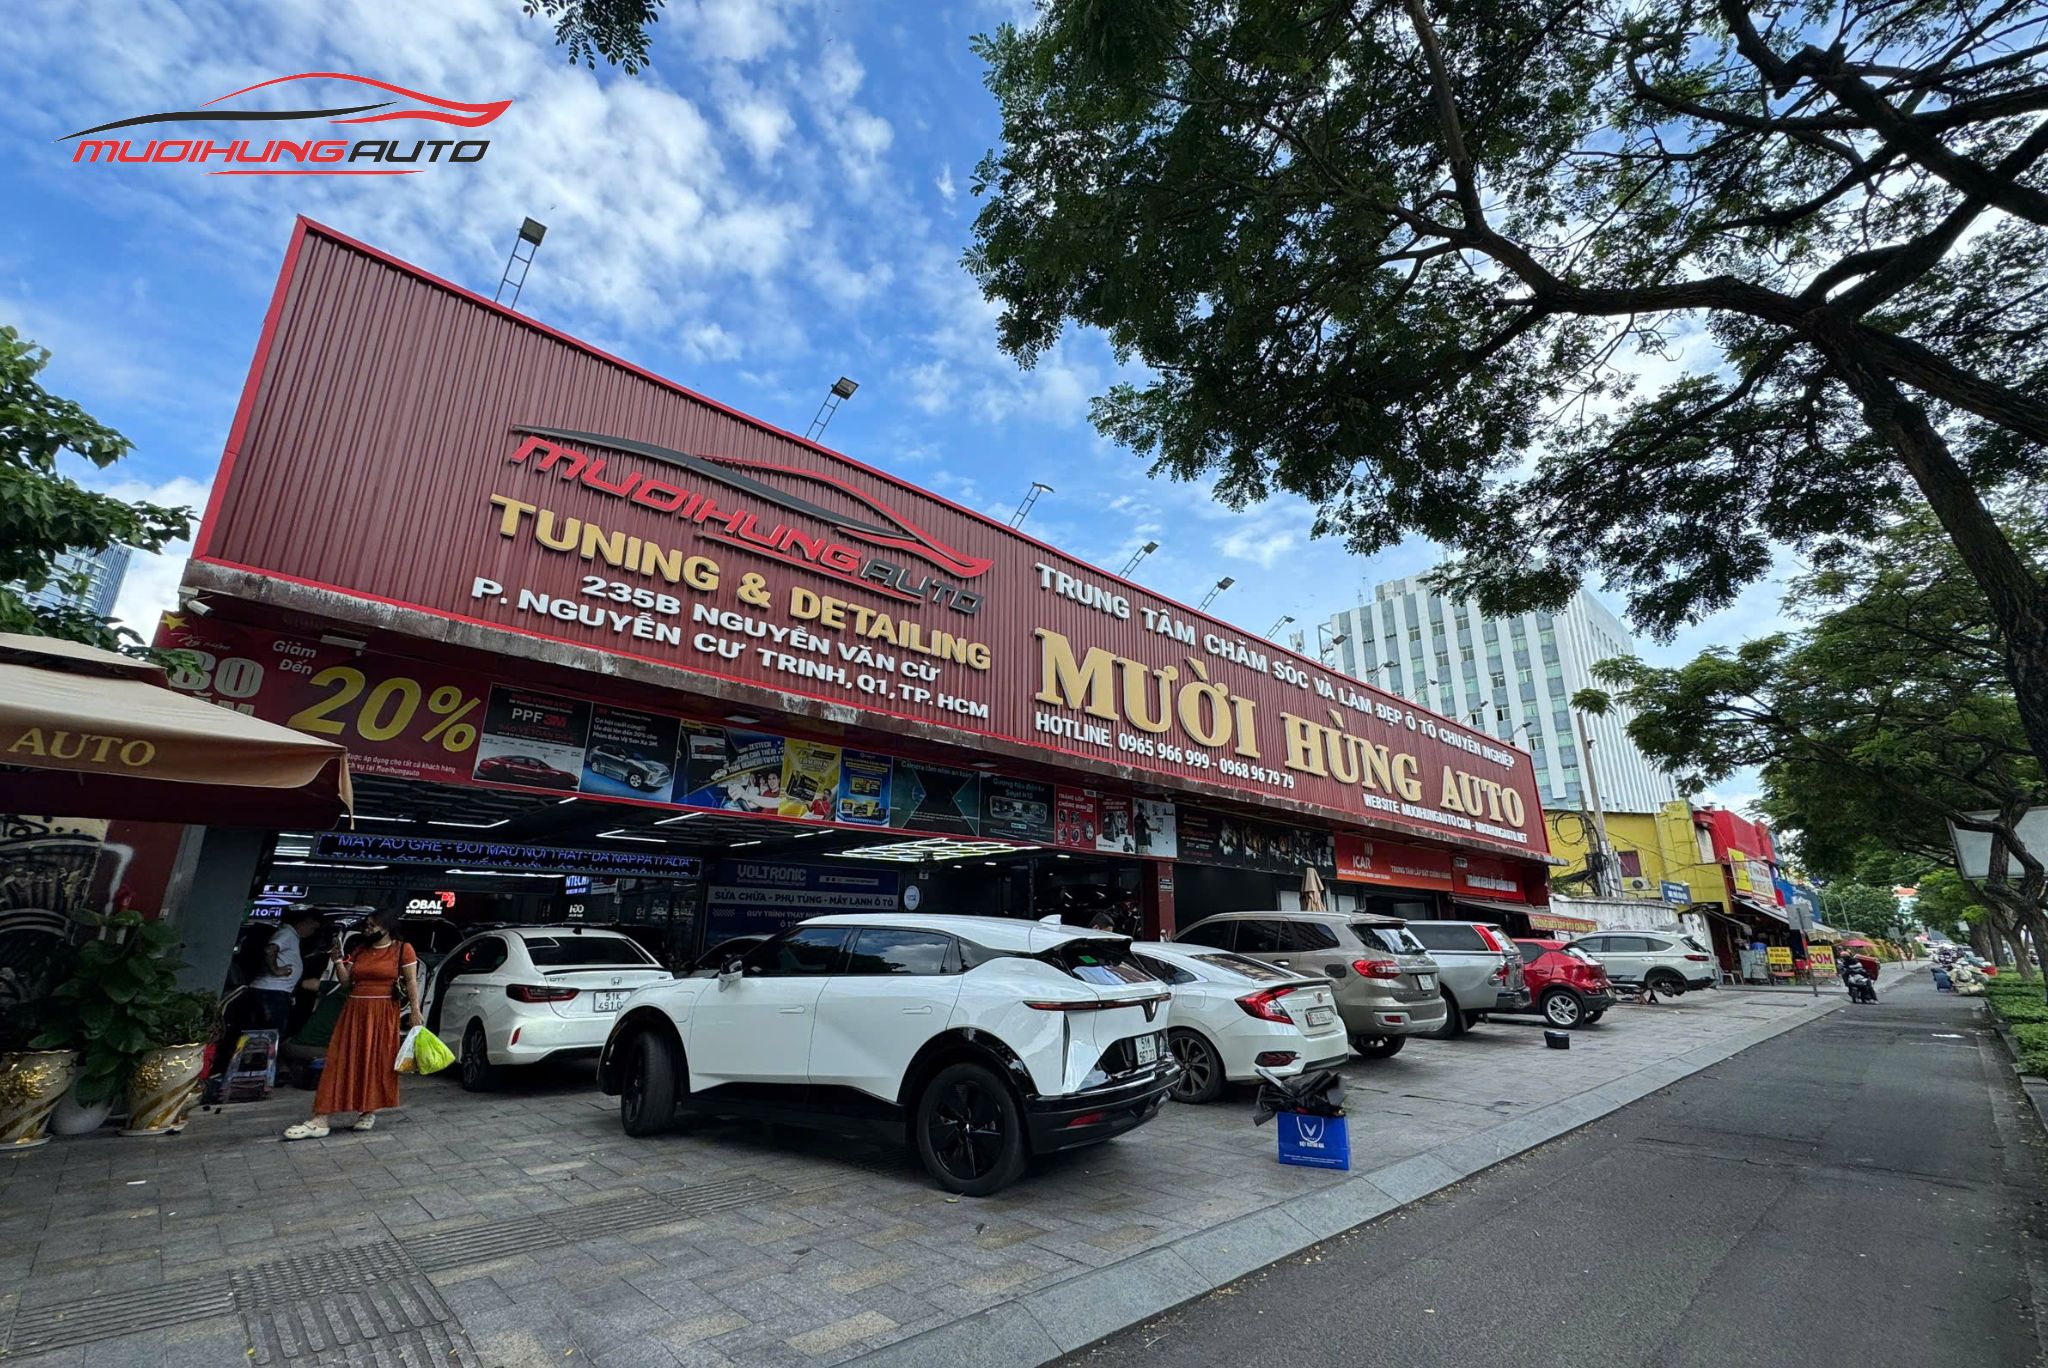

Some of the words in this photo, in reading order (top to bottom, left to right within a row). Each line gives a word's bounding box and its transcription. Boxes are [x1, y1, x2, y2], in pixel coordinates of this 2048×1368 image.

[490, 493, 721, 592] TUNING
[736, 571, 772, 609] &
[791, 586, 991, 671] DETAILING
[272, 638, 318, 659] Giảm
[471, 576, 508, 605] P.
[517, 588, 682, 646] NGUYỄN
[693, 632, 747, 660] CƯ
[937, 692, 990, 719] HCM
[581, 575, 681, 615] 235B
[692, 602, 831, 656] NGUYỄN
[837, 640, 896, 673] VĂN
[901, 660, 941, 683] CỪ
[279, 658, 313, 676] Đến
[1034, 562, 1131, 620] TRUNG
[1140, 607, 1196, 647] TÂM
[1203, 633, 1268, 674] CHĂM
[1272, 659, 1309, 689] SÓC
[1313, 674, 1336, 701] VÀ
[1338, 684, 1373, 715] LÀM
[1375, 702, 1403, 727] ĐẸP
[1405, 711, 1417, 732] Ô
[1418, 719, 1437, 739] TÔ
[1438, 727, 1482, 757] CHUYÊN
[1482, 744, 1516, 771] NGHIỆP
[287, 665, 482, 754] 20%
[511, 707, 544, 724] PPF
[1034, 627, 1261, 761] MƯỜI
[1281, 708, 1423, 802] HÙNG
[1440, 764, 1526, 829] AUTO
[7, 727, 156, 767] AUTO
[1118, 732, 1154, 758] 0965
[1157, 742, 1182, 764] 966
[1185, 749, 1210, 769] 999
[1219, 757, 1249, 779] 0968
[1352, 855, 1371, 870] ICAR
[715, 887, 736, 900] SỬA
[738, 889, 766, 901] CHỮA
[775, 893, 795, 904] PHỤ
[797, 892, 823, 905] TÙNG
[829, 893, 847, 906] MÁY
[850, 896, 873, 908] LẠNH
[874, 896, 881, 906] Ô
[883, 896, 894, 907] TÔ
[605, 992, 621, 1001] 51K
